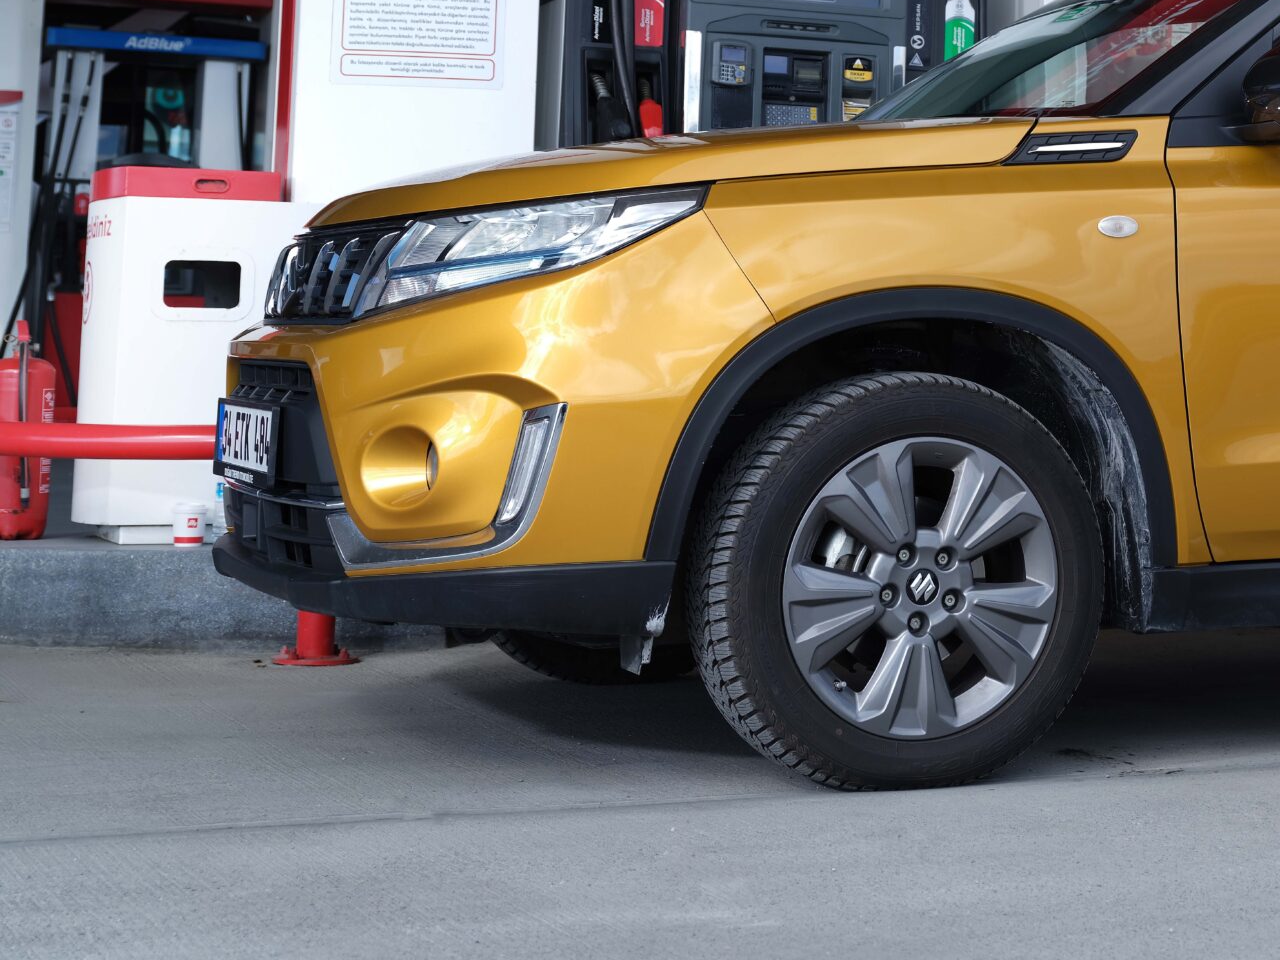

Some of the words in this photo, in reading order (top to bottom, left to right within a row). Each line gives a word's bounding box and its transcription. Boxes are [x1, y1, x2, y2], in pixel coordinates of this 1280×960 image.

[124, 36, 184, 51] AdBlue
[222, 410, 231, 456] 34
[234, 412, 251, 461] ETK
[254, 415, 270, 466] 484
